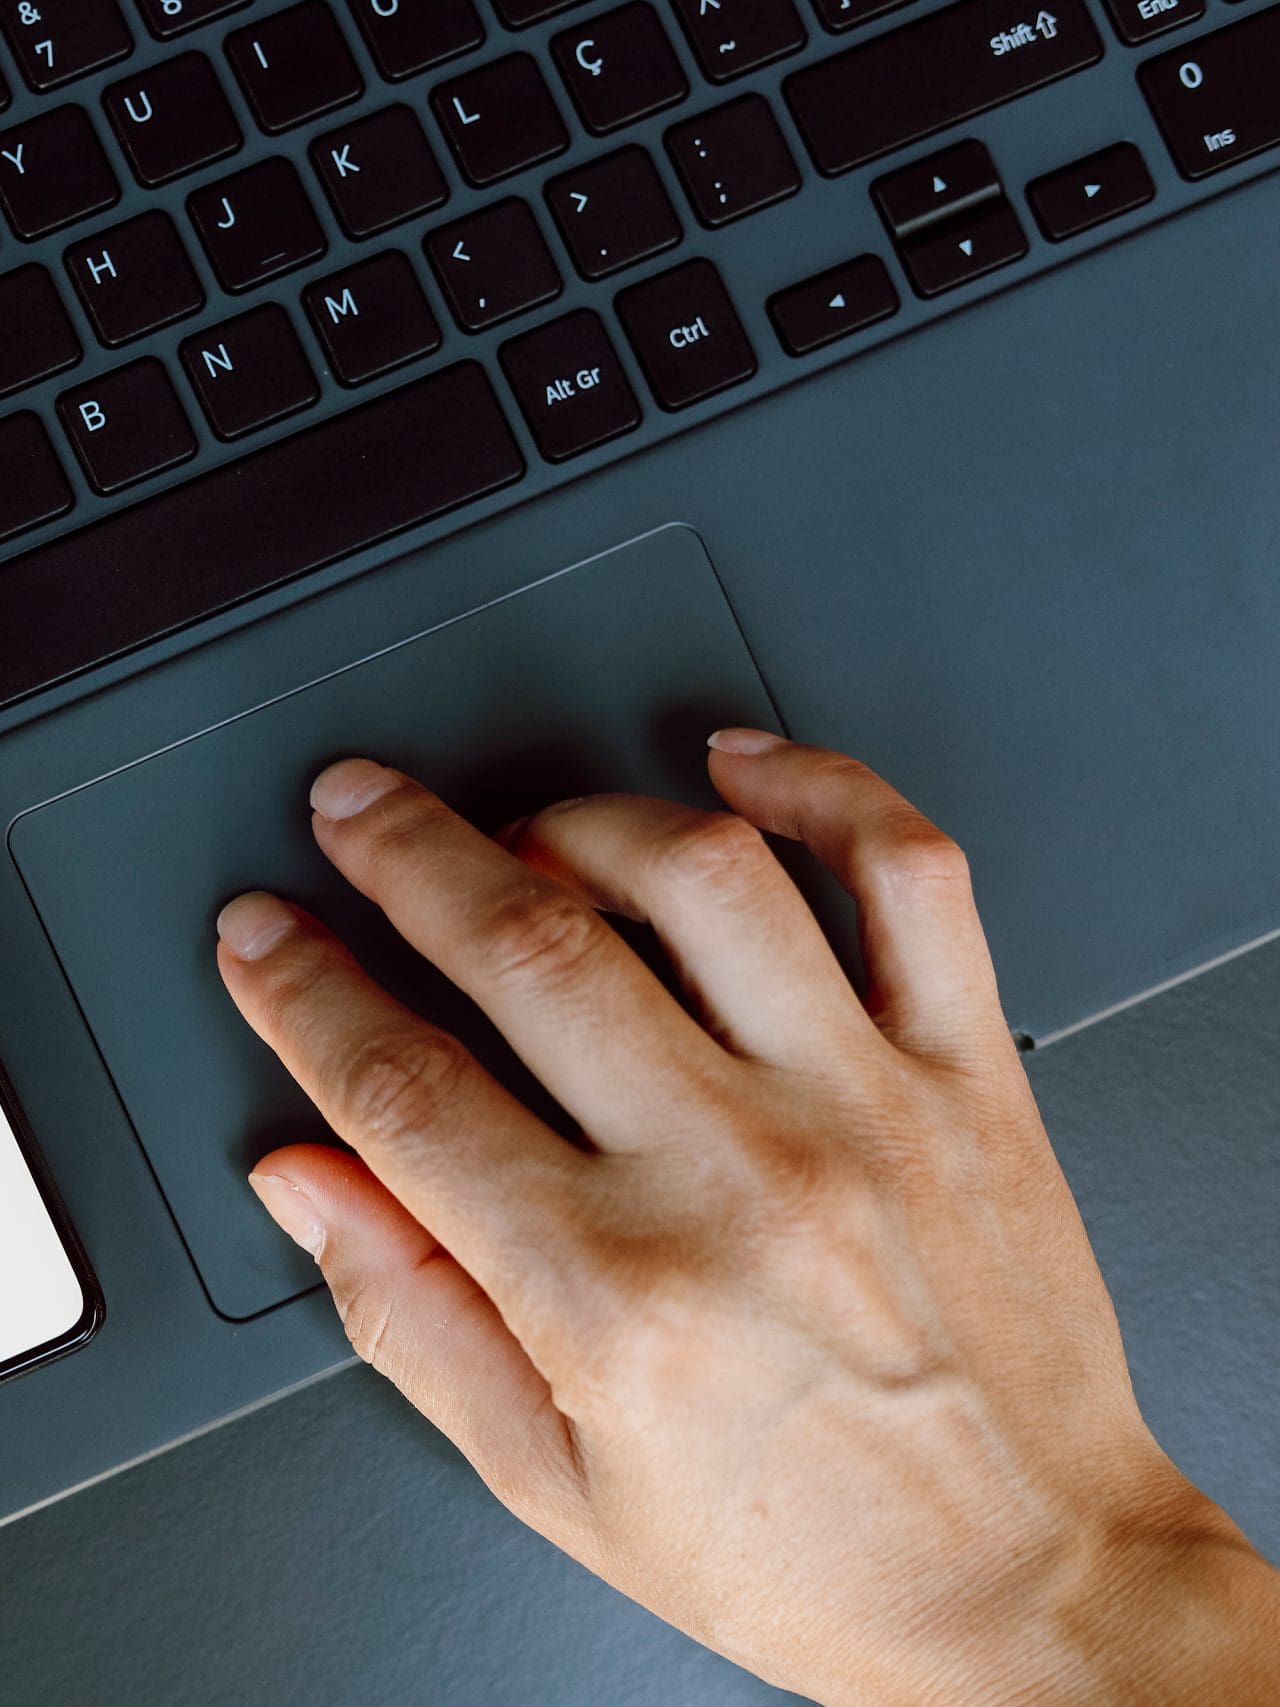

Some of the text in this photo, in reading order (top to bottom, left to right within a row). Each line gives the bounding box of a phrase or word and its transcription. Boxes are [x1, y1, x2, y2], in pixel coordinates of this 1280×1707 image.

[19, 2, 40, 24] &
[35, 40, 53, 66] 7
[991, 24, 1036, 55] Shift
[253, 42, 267, 68] I
[576, 40, 602, 75] Ç
[125, 92, 152, 122] U
[453, 98, 479, 124] L
[1204, 129, 1236, 152] Ins
[2, 144, 24, 174] Y
[331, 145, 359, 177] K
[219, 198, 235, 228] J
[570, 192, 586, 211] >
[453, 241, 469, 260] <
[87, 251, 117, 284] H
[325, 289, 358, 323] M
[670, 318, 708, 347] Ctrl
[203, 344, 232, 377] N
[547, 367, 600, 404] Alt Gr
[79, 401, 105, 431] B
